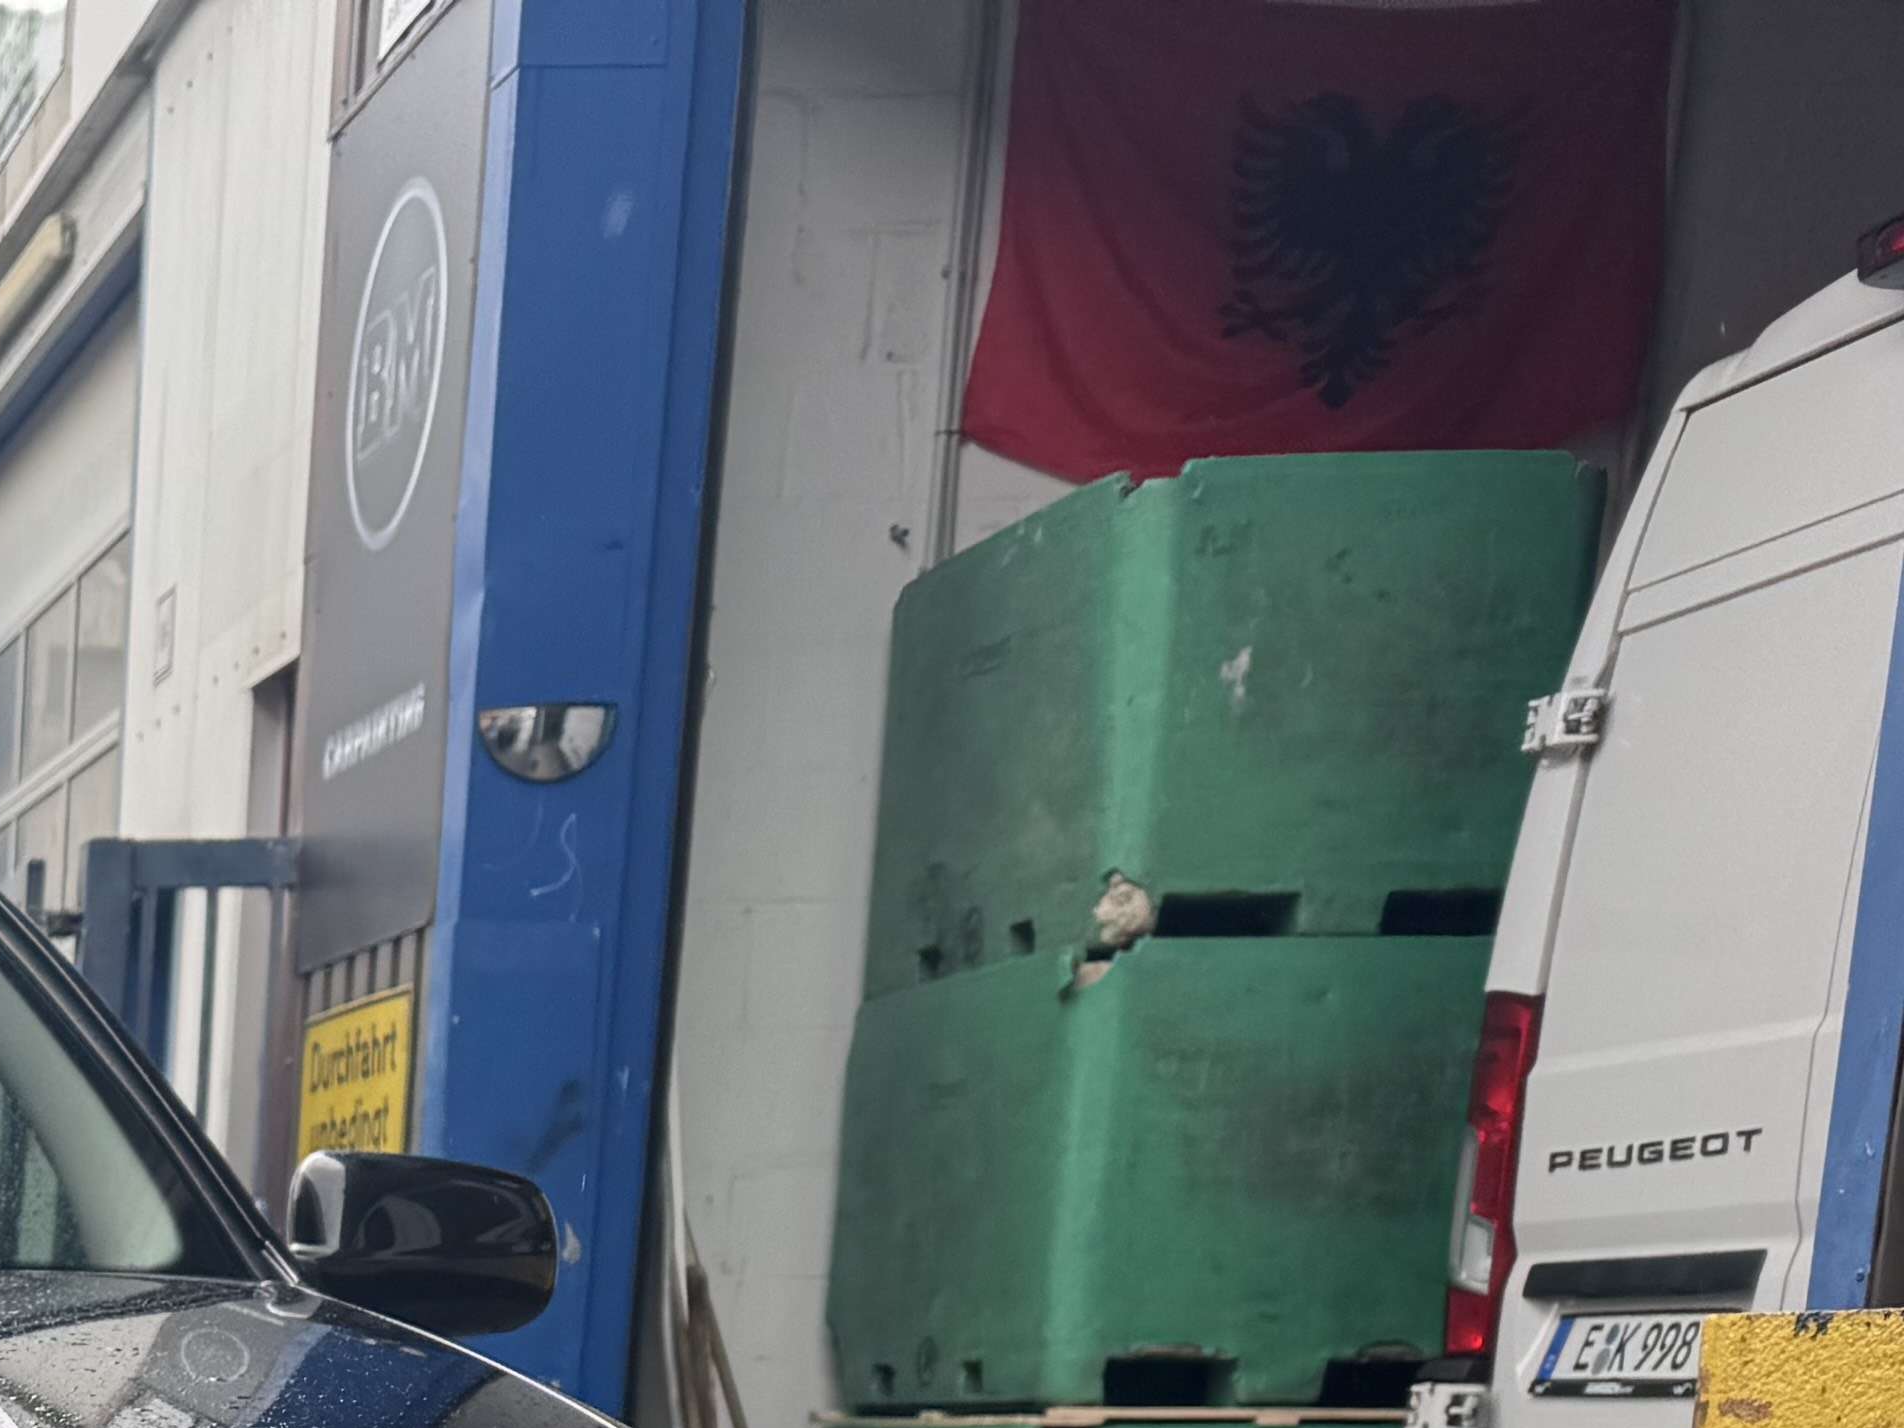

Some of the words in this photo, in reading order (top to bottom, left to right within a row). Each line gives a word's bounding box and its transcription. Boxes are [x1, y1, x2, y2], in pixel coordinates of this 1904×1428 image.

[309, 1022, 397, 1093] Durchfahrt
[1548, 1127, 1763, 1173] PEUGEOT
[1573, 1324, 1604, 1371] E
[1608, 1322, 1641, 1371] K
[1634, 1320, 1700, 1371] 998
